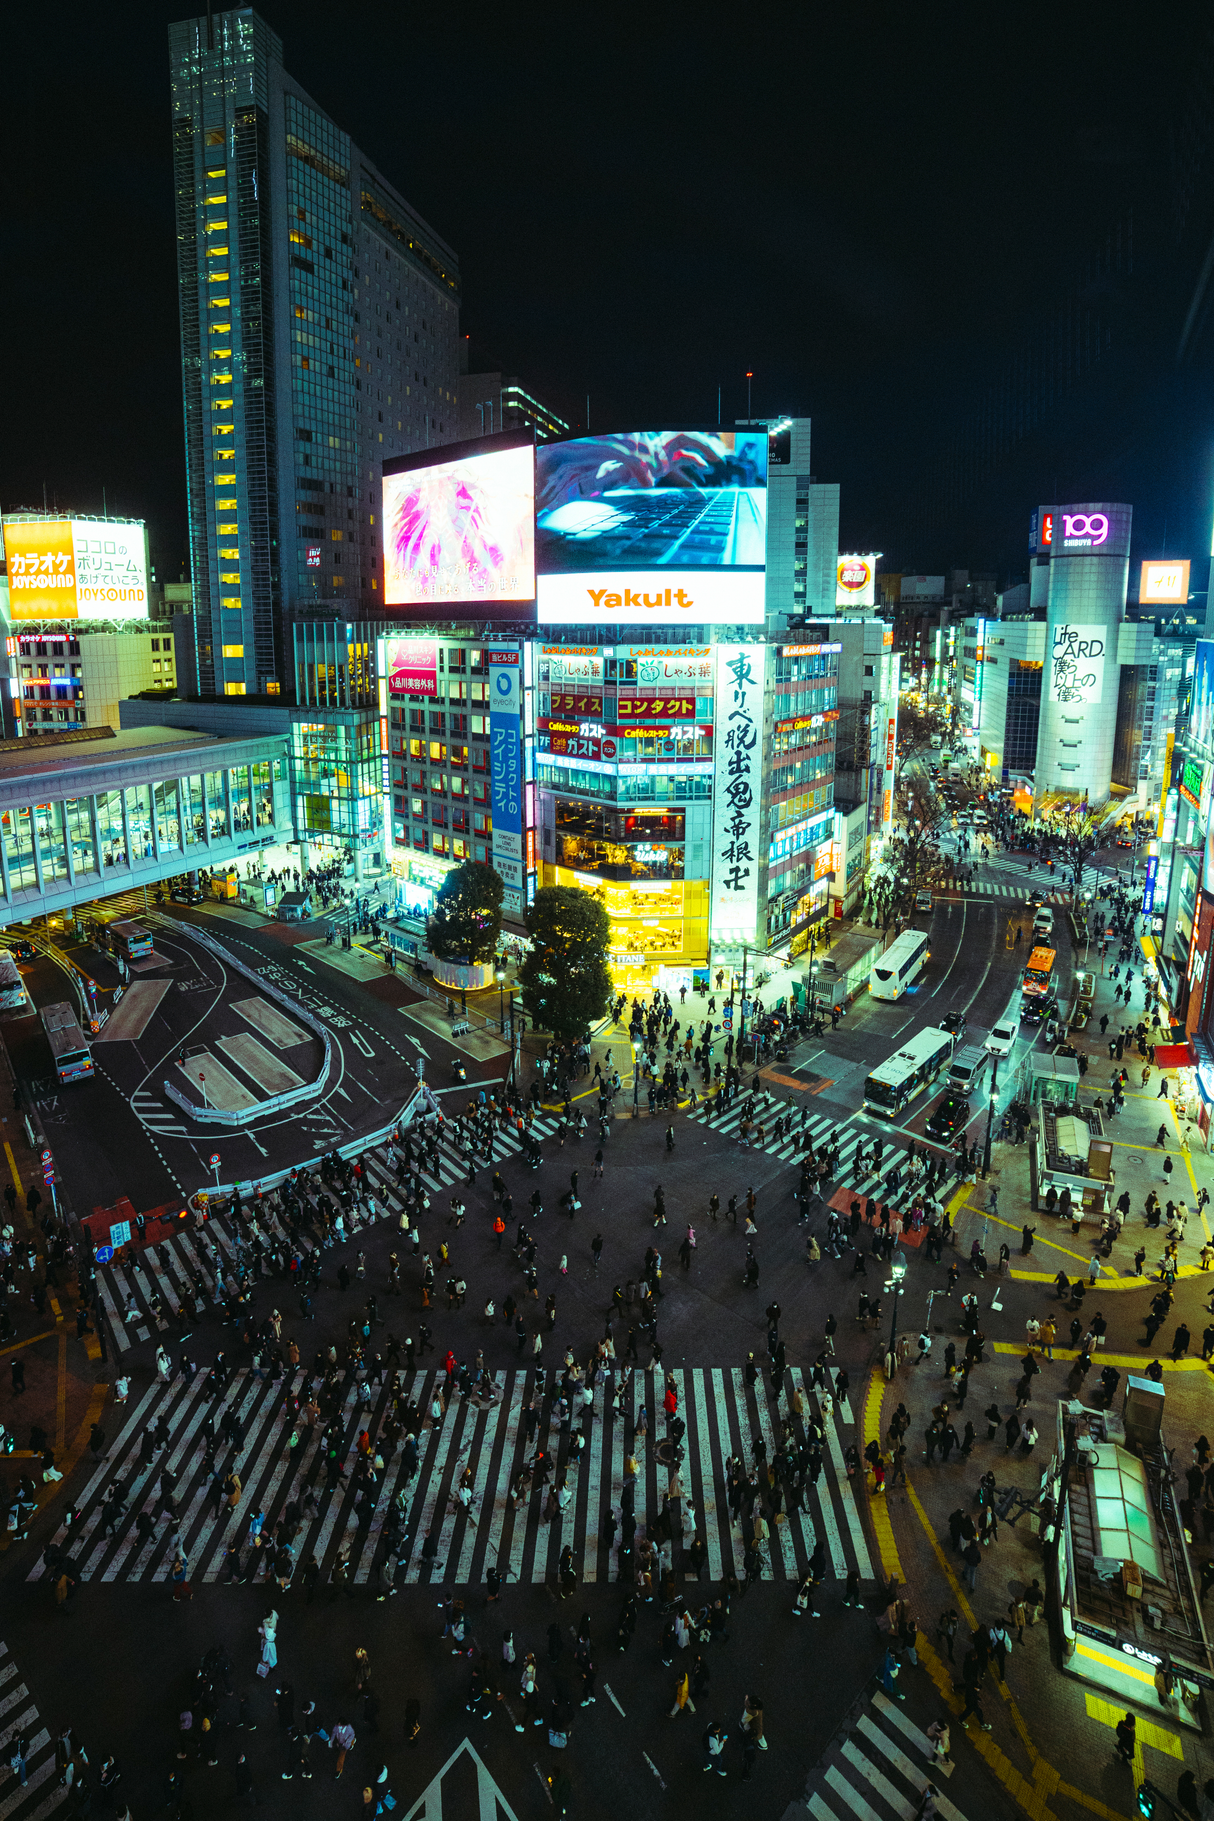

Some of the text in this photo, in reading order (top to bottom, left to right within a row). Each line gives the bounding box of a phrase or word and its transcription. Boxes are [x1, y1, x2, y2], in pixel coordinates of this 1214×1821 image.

[1063, 514, 1108, 545] 109
[77, 539, 127, 555] ココロの
[11, 552, 72, 573] カラオケ
[78, 556, 142, 573] ボリューム、
[12, 574, 74, 589] JOYSOUND
[79, 573, 144, 586] あげていこう。
[467, 577, 520, 594] 本当の世界
[79, 588, 144, 601] JOYSOUND
[587, 589, 694, 608] Yakult
[1053, 624, 1079, 644] Life
[491, 653, 516, 662] 当ビル5F
[1052, 640, 1105, 660] CARD.
[540, 663, 549, 673] 9F
[568, 662, 600, 677] しゃぶ葉
[664, 663, 711, 678] しゃぶ葉
[395, 678, 434, 691] 品川美容外科
[1054, 673, 1096, 689] 以上の
[493, 698, 516, 708] eyecity
[551, 695, 602, 712] プライス
[619, 700, 693, 714] コンタクト
[580, 723, 606, 738] ガスト
[670, 727, 705, 739] ガスト
[540, 736, 550, 746] 7F
[567, 739, 598, 756] ガスト
[493, 728, 505, 812] アイシティ
[769, 838, 791, 859] AGA
